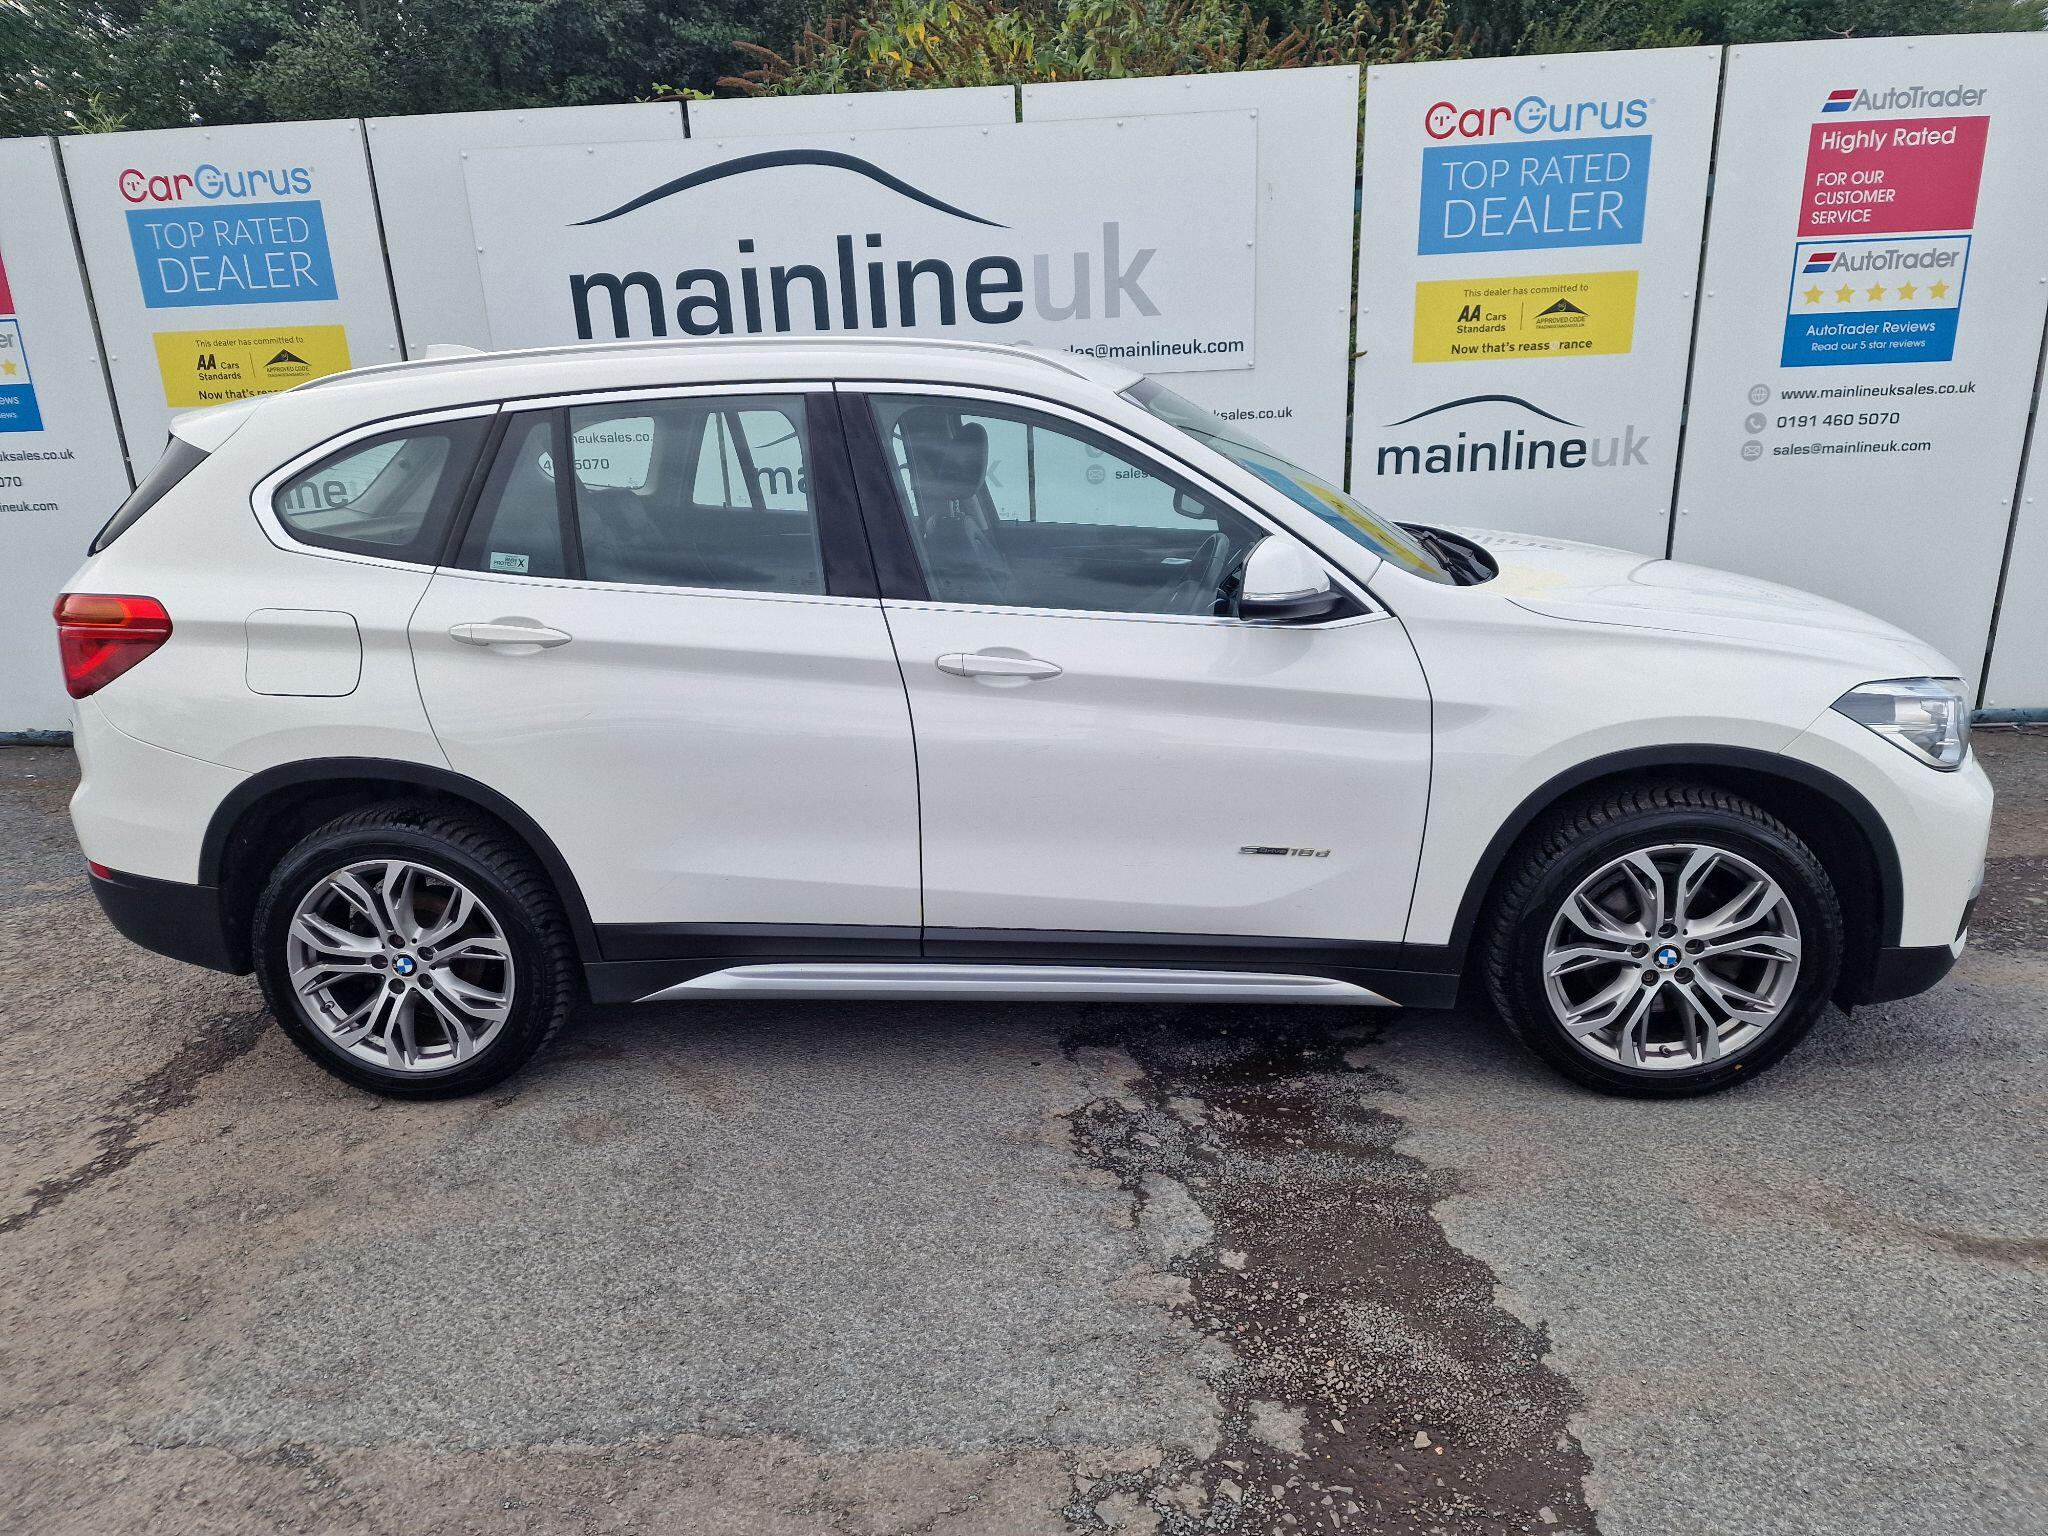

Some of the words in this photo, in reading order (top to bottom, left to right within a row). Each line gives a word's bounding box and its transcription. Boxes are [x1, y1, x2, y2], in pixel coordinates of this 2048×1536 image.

[1852, 85, 1987, 112] AutoTrader
[1425, 95, 1648, 140] CarGurus
[1821, 130, 1888, 154] Highly
[1892, 126, 1957, 147] Rated
[1441, 159, 1509, 191] TOP
[1520, 152, 1631, 187] RATED
[1816, 171, 1847, 187] FOR
[1851, 170, 1885, 185] OUR
[119, 164, 312, 203] CarGurus
[1814, 189, 1896, 206] CUSTOMER
[1443, 190, 1624, 239] DEALER
[1811, 208, 1872, 225] SERVICE
[144, 221, 204, 250] TOP
[213, 216, 309, 247] RATED
[1831, 248, 1960, 273] AutoTrader
[158, 251, 319, 294] DEALER
[568, 221, 1163, 340] mainlineuk
[1464, 289, 1481, 297] This
[1483, 288, 1511, 296] dealer
[1513, 286, 1528, 294] has
[1530, 284, 1578, 294] committed
[1580, 284, 1589, 292] to
[1457, 305, 1481, 322] AA
[1485, 312, 1507, 321] Cars
[1536, 317, 1568, 325] APPROVED
[1456, 324, 1506, 334] Standards
[1806, 323, 1880, 336] AutoTrader
[1882, 321, 1936, 334] Reviews
[196, 340, 211, 348] This
[213, 339, 237, 347] dealer
[238, 338, 252, 346] has
[253, 336, 294, 345] committed
[1062, 339, 1244, 358] les@mainlineuk.com
[1450, 344, 1479, 354] Now
[1482, 342, 1515, 353] that's
[1518, 340, 1592, 352] reassrance
[1811, 341, 1838, 351] Read
[1860, 341, 1866, 349] 5
[1868, 340, 1887, 349] star
[1889, 339, 1926, 348] reviews
[197, 353, 216, 370] AA
[220, 361, 240, 369] Cars
[198, 371, 242, 381] Standards
[198, 390, 223, 400] Now
[1781, 381, 1976, 400] www.mainlineuksales.co.uk
[1777, 415, 1817, 428] 0191
[1822, 414, 1854, 426] 460
[1858, 412, 1900, 425] 5070
[1377, 424, 1651, 475] mainlineuk
[1773, 440, 1931, 456] sales@mainlineuk.com
